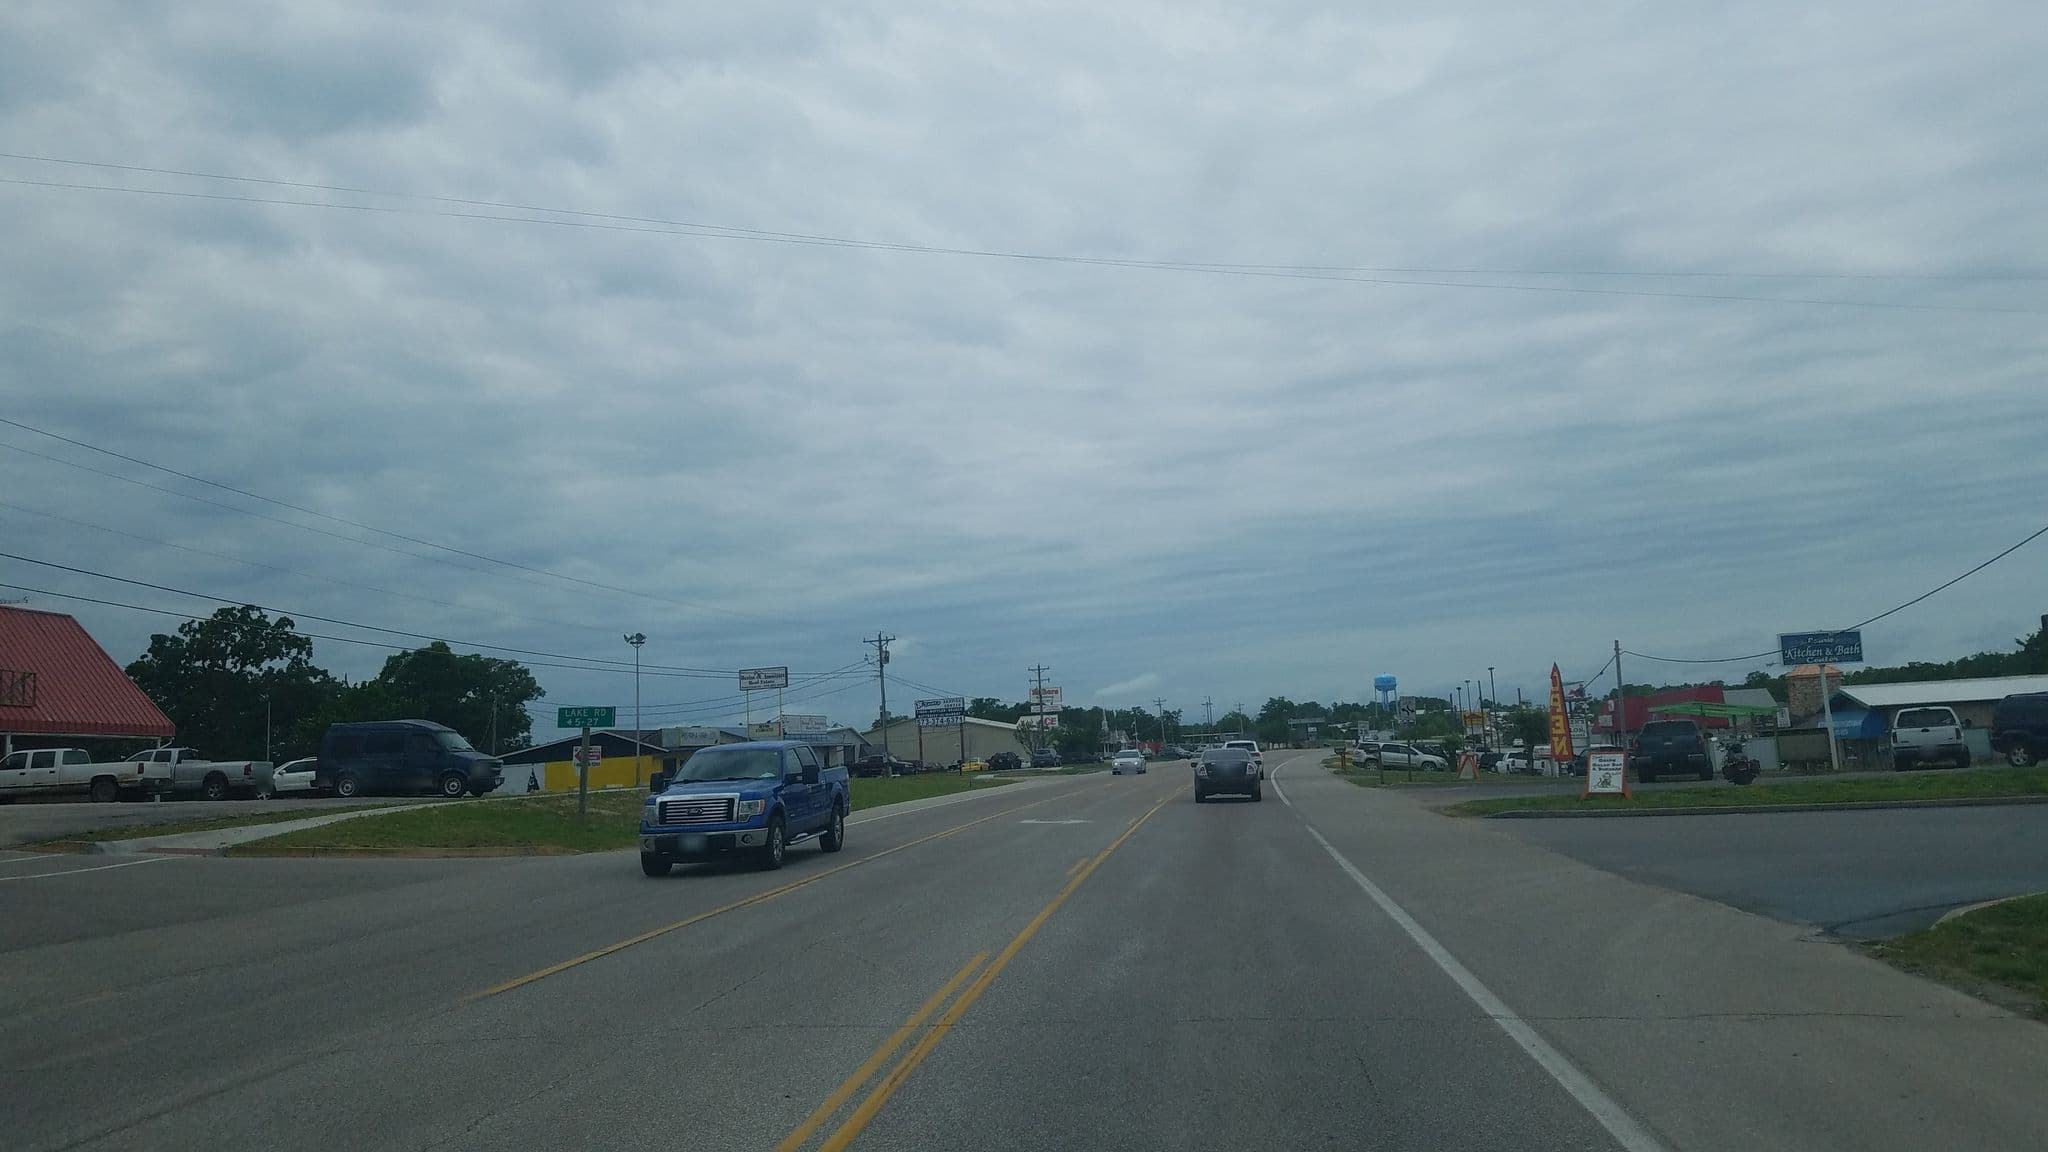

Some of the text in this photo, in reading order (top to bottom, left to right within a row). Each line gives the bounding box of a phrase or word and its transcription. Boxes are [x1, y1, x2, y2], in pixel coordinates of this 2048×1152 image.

[1784, 642, 1860, 660] Kitchen & Bath
[565, 708, 607, 718] LAKE RD
